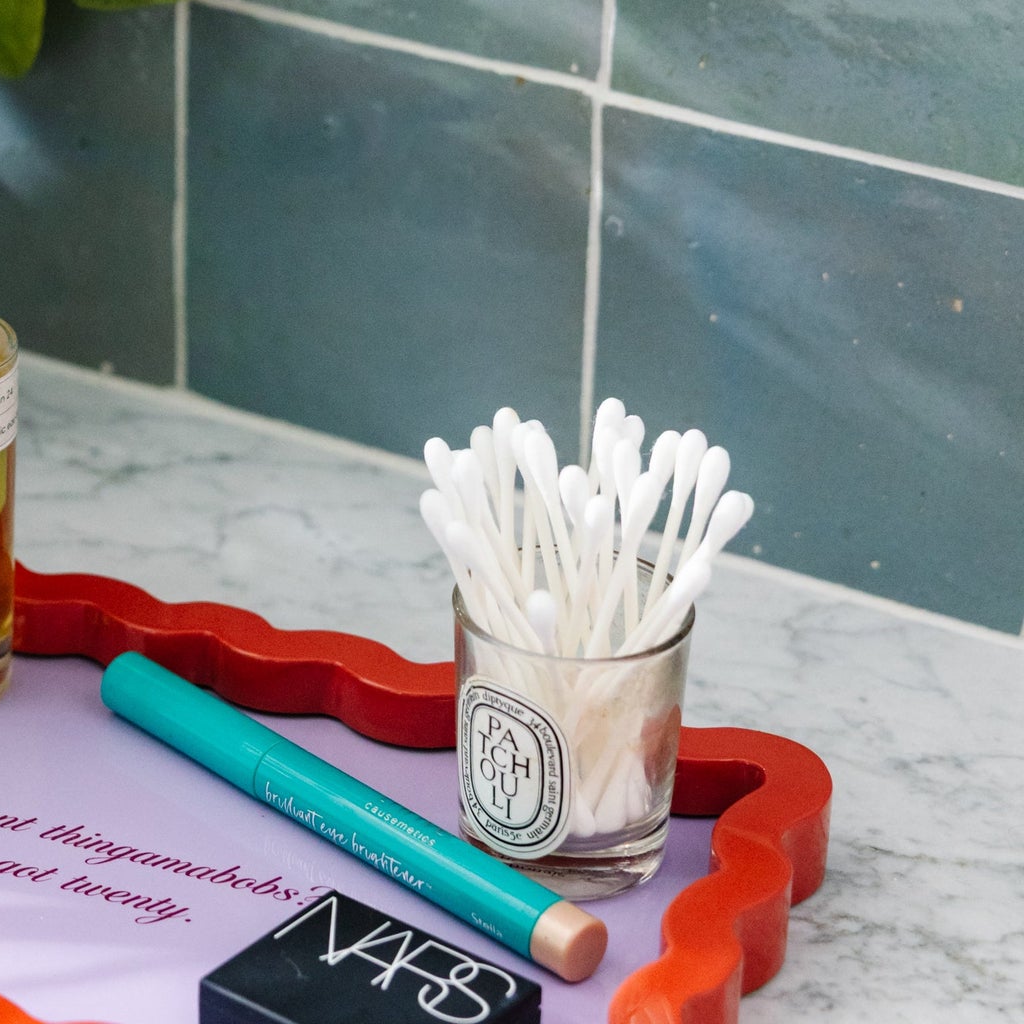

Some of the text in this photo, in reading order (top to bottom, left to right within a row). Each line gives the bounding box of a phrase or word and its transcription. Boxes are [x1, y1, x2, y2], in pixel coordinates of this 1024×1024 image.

[482, 691, 525, 716] diptyque
[539, 727, 557, 778] boulevard
[549, 780, 557, 806] saint
[265, 781, 323, 831] brilliant
[60, 875, 193, 925] twenty.
[274, 895, 517, 1024] NARS
